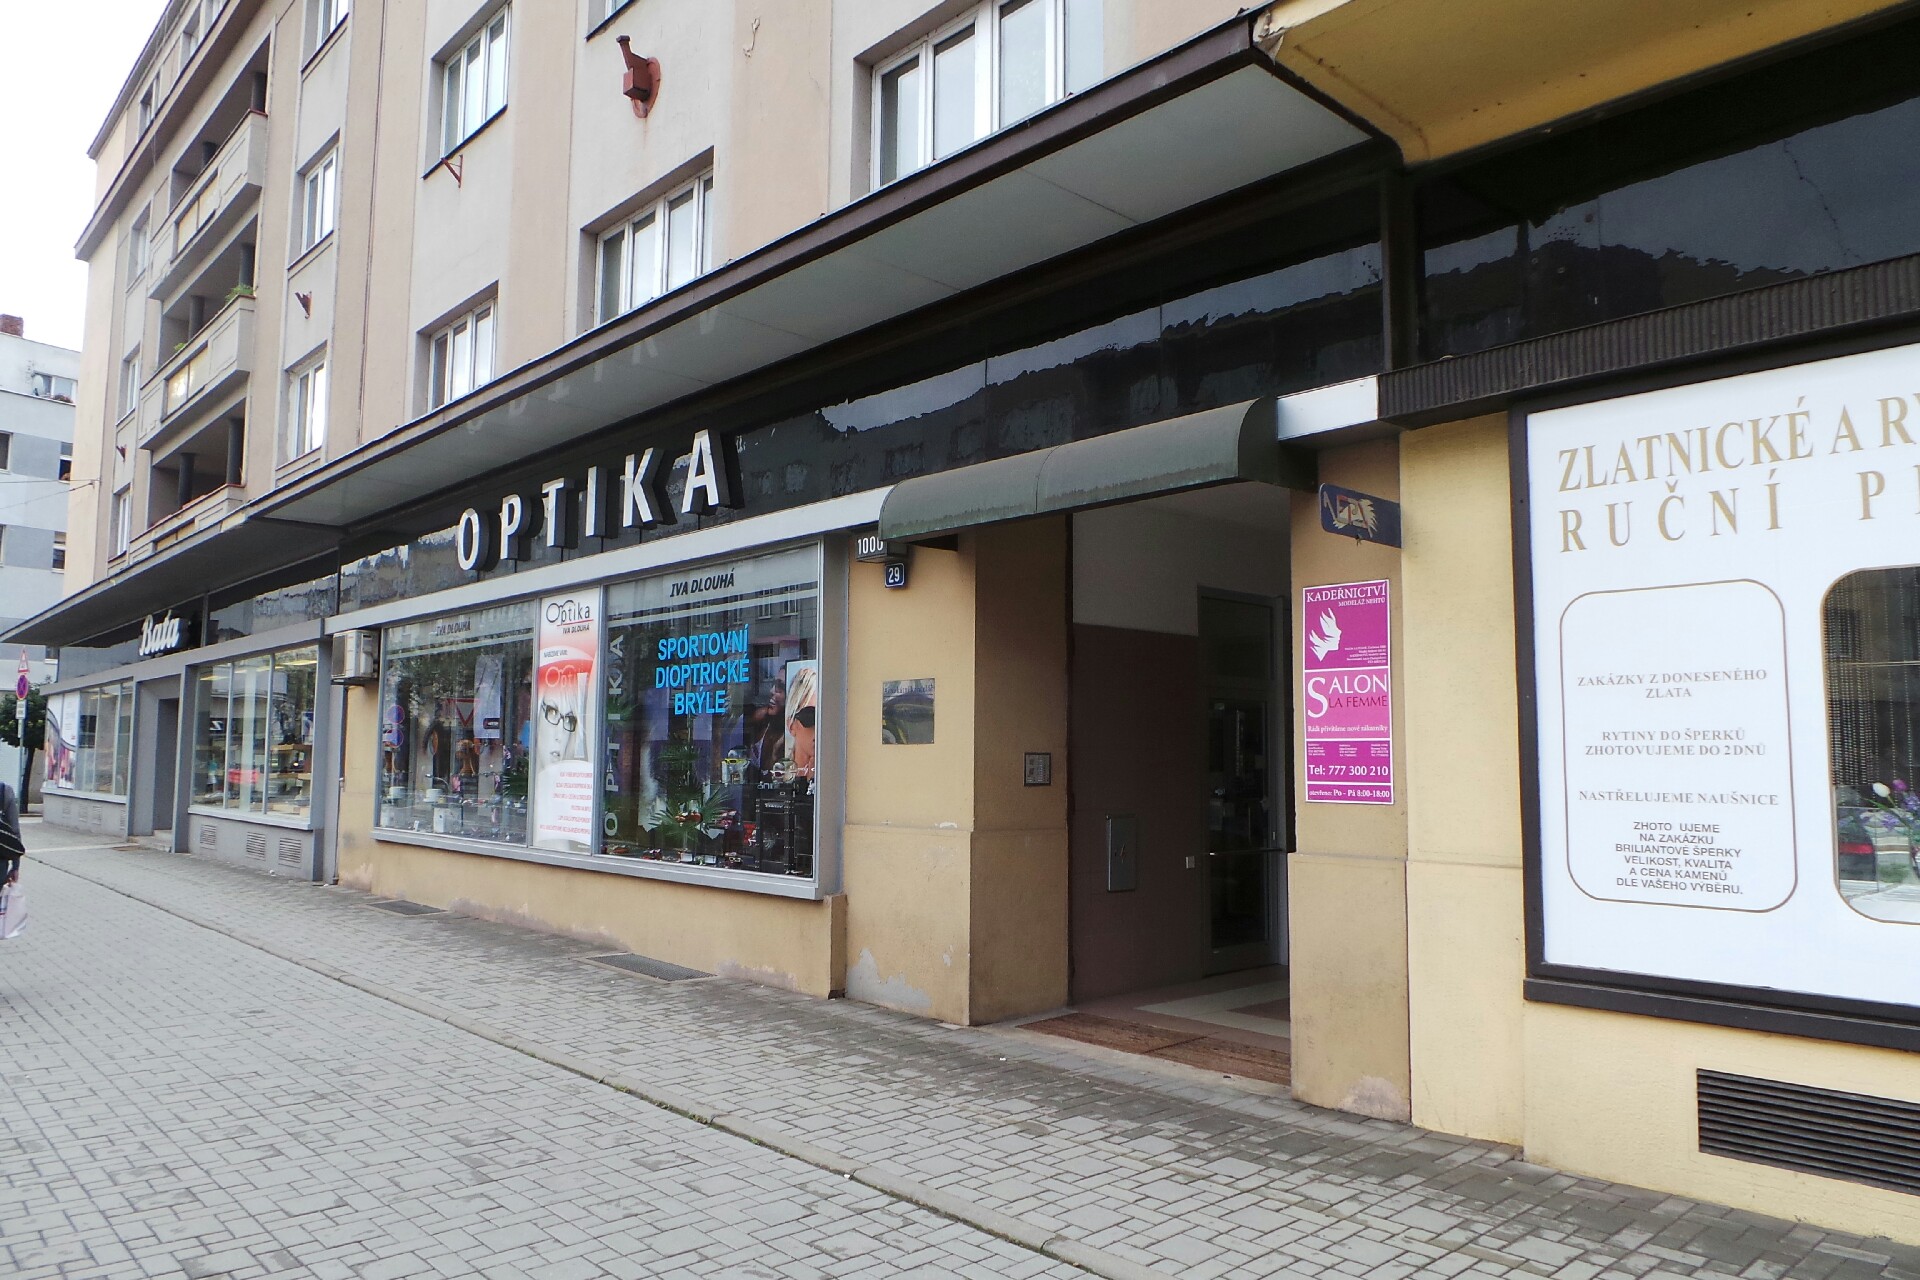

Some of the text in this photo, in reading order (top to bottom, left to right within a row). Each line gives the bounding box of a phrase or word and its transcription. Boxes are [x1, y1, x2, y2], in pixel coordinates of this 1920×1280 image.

[1558, 392, 1920, 492] ZLATNICKÉ A R
[457, 428, 720, 571] OPTIKA
[1559, 463, 1920, 553] RUČNÍ P
[670, 568, 735, 597] IVA DLOUHÁ
[888, 566, 900, 583] 29
[1306, 583, 1386, 602] KADEŘNICTVÍ
[545, 599, 590, 624] Optika
[571, 624, 590, 634] DLOUHÁ
[657, 623, 749, 661] SPORTOVNÍ
[655, 654, 750, 689] DIOPTRICKÉ
[1577, 667, 1768, 687] ZAKÁZKY Z DONESENÉHO
[674, 686, 726, 715] BRÝLE
[1307, 673, 1388, 718] SALON
[1328, 695, 1388, 708] LA FEMME
[1645, 687, 1692, 699] ZLATA
[1602, 727, 1746, 741] RYTINY DO ŠPERKŮ
[1585, 745, 1695, 756] ZHOTOVUJEME
[1699, 745, 1720, 756] DO
[1308, 765, 1389, 776] Tel: 777 300 210
[1333, 789, 1342, 797] Po
[1579, 788, 1780, 806] NASTŘELUJEME NAUŠNICE
[1639, 832, 1714, 845] NA ZAKÁZKU
[1615, 843, 1741, 858] BRILIANTOVÉ ŠPERKY
[1624, 855, 1733, 869] VELIKOST, KVALITA
[1629, 867, 1728, 881] A CENA KAMENŮ
[1616, 877, 1744, 895] DLE VAŠEHO VÝBĚRU.
